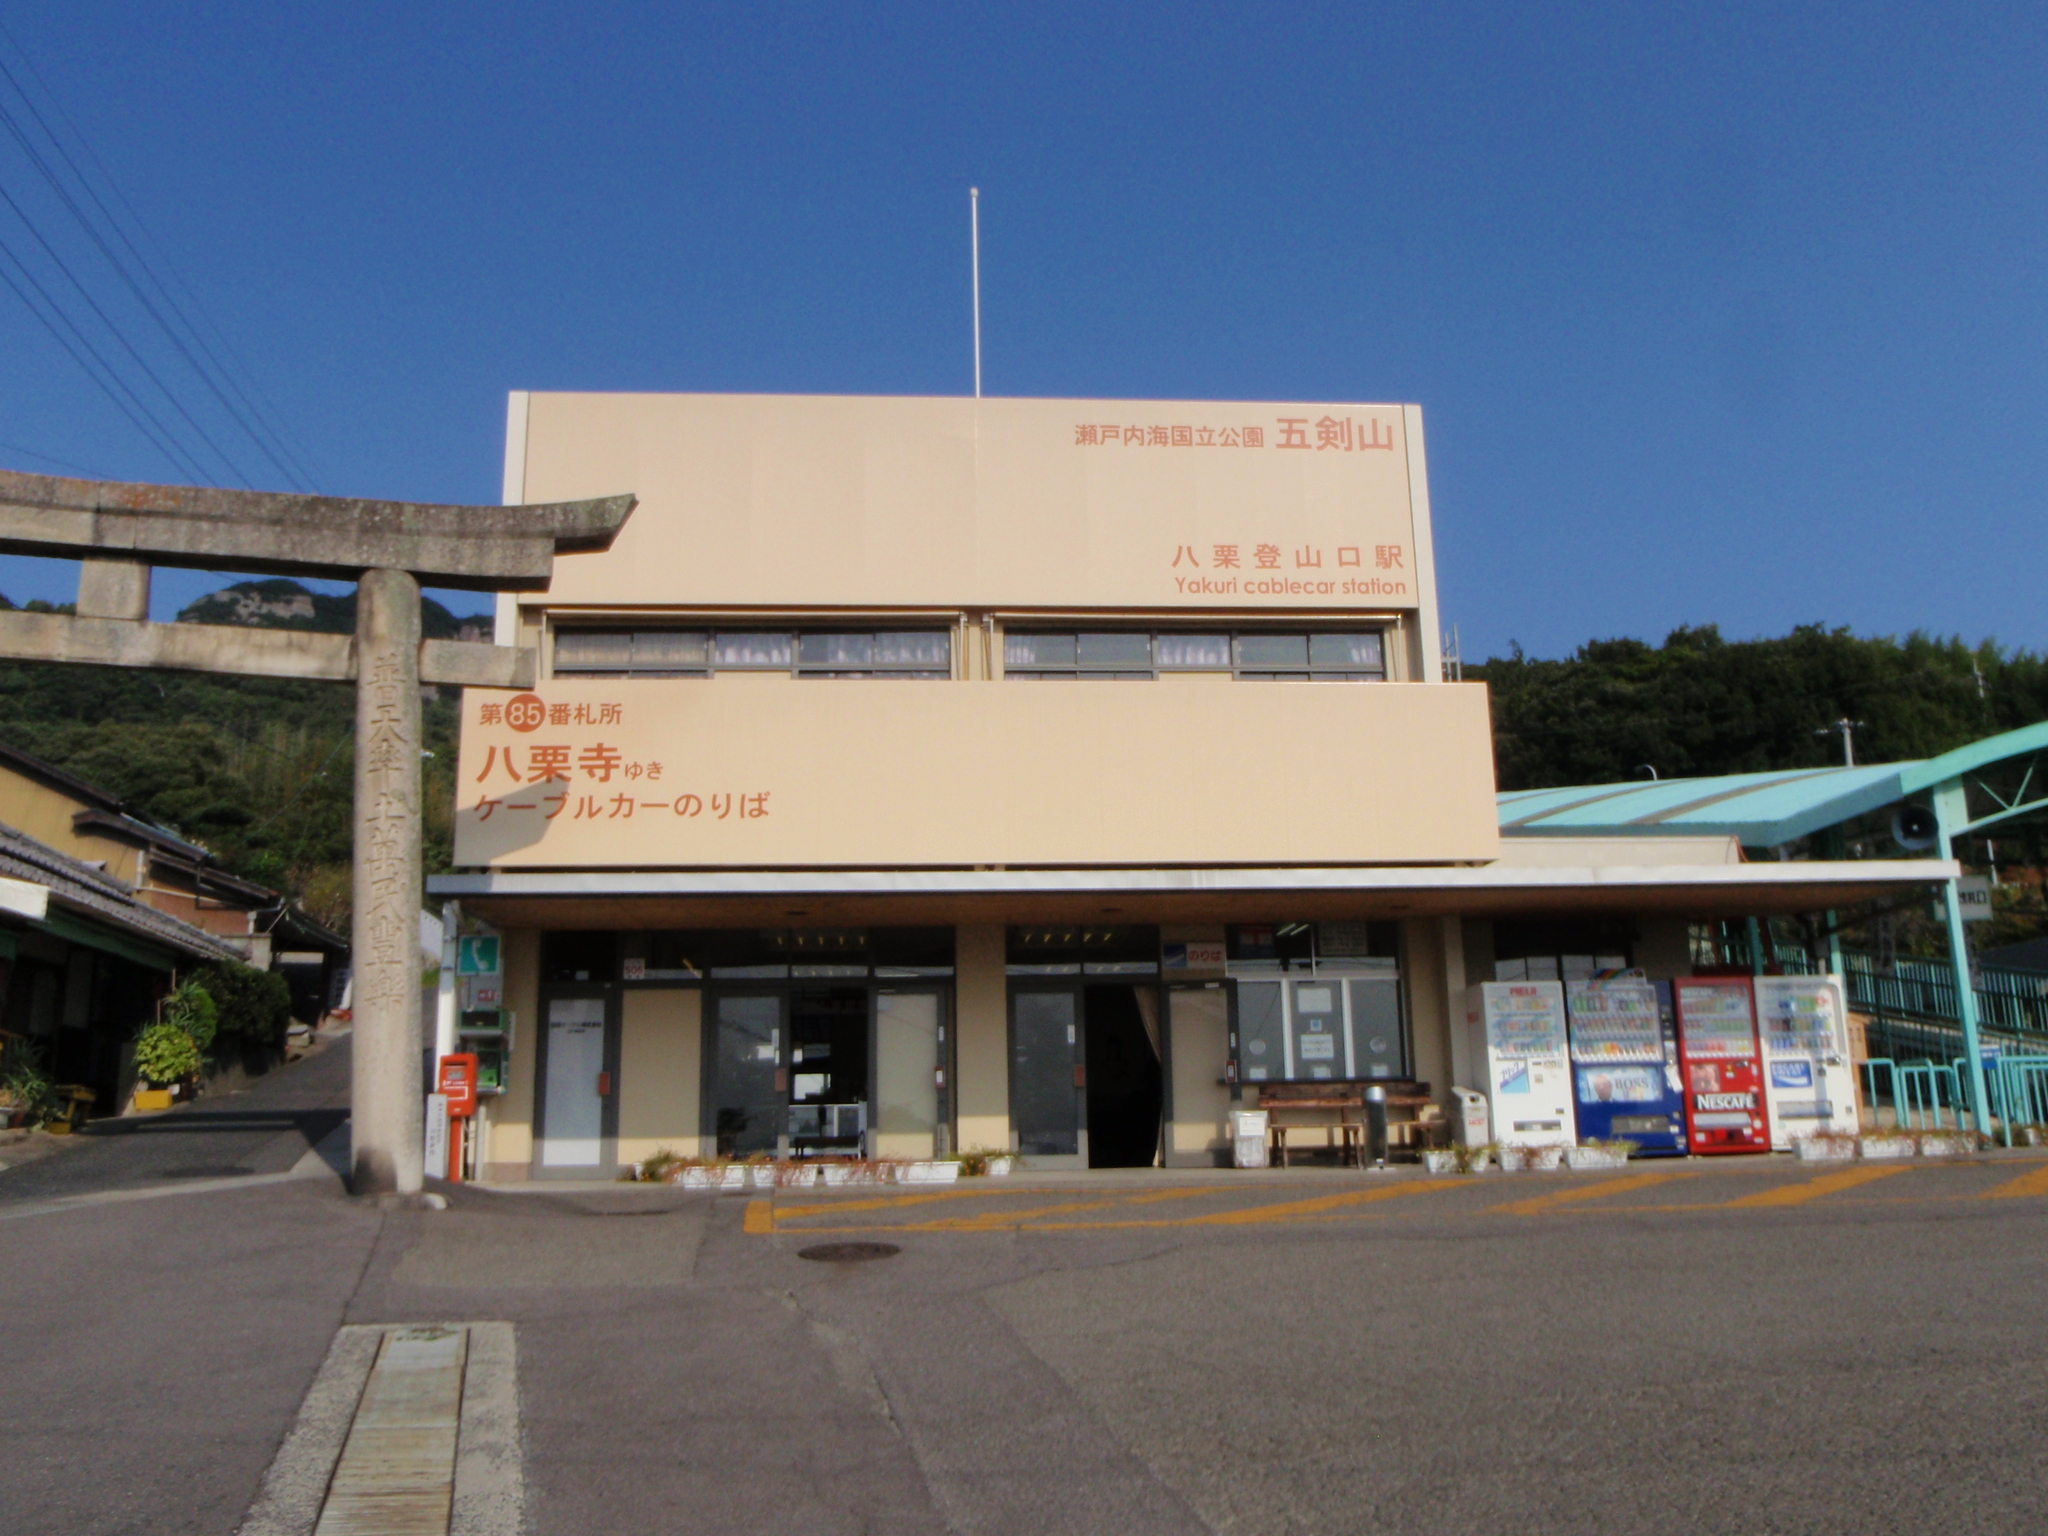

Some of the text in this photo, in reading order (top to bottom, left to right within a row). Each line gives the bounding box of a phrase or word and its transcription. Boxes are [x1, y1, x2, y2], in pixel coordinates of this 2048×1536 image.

[1074, 415, 1395, 452] 瀬戸内海国立公園 五剣山
[1171, 543, 1405, 570] 八栗登山口駅
[1174, 576, 1407, 596] Yakuri cablecar station
[479, 694, 624, 733] 第85番札所
[473, 790, 771, 822] ケーブルカーのりば
[1188, 949, 1222, 962] のりば
[1614, 1076, 1650, 1090] BOSS
